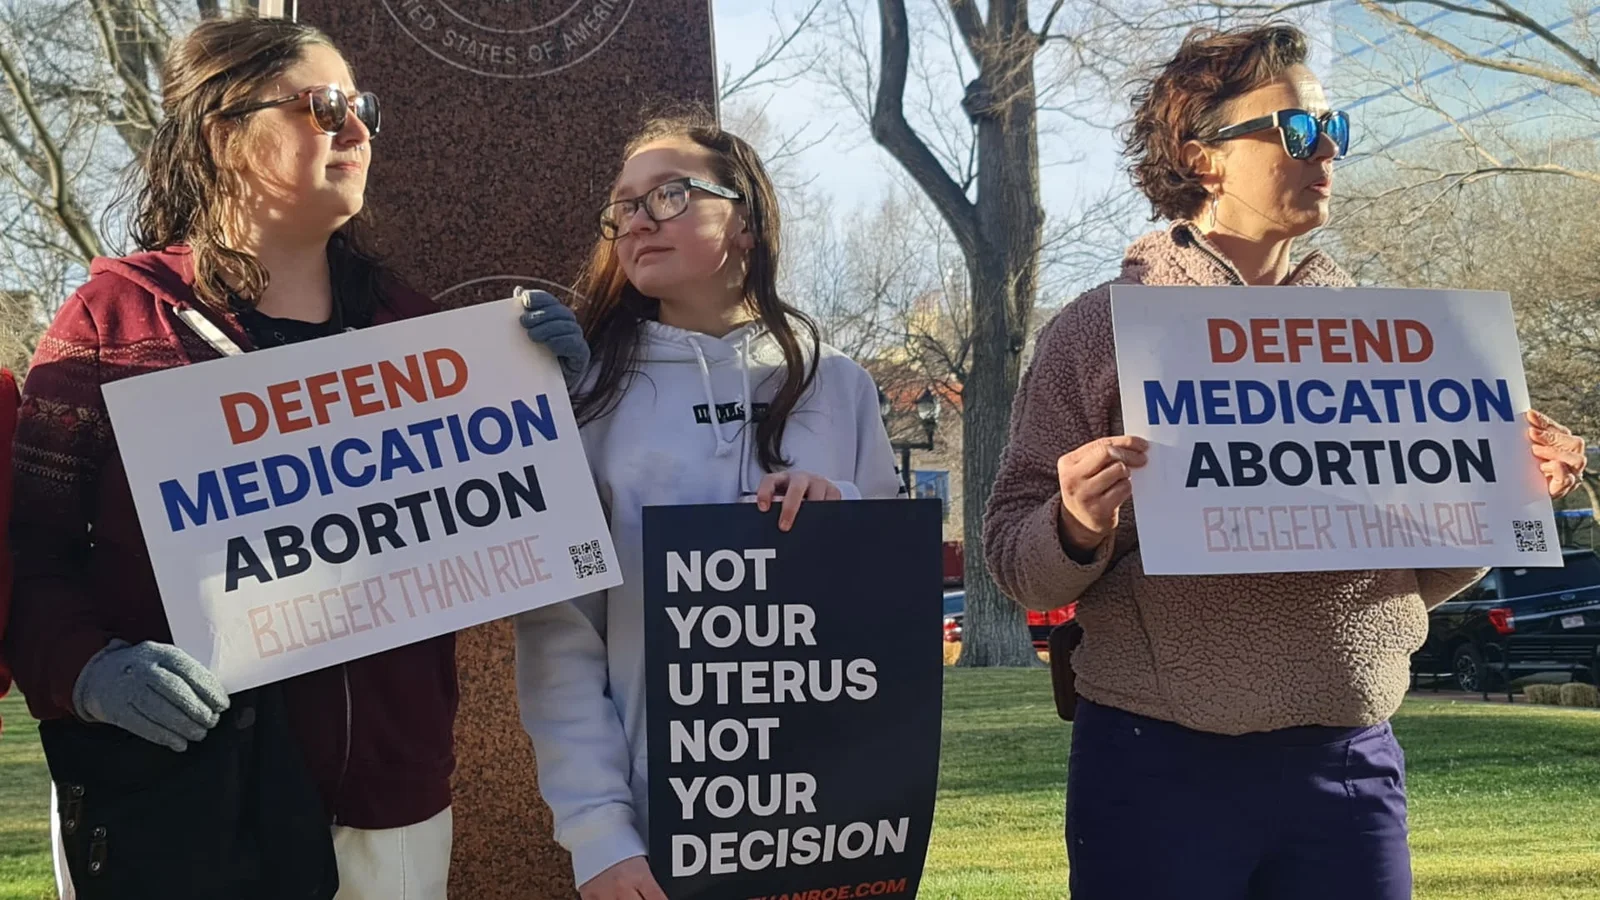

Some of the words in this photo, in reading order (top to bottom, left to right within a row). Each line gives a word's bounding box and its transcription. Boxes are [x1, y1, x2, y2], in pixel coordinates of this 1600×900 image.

[441, 30, 517, 64] STATES
[528, 40, 554, 62] OF
[561, 0, 619, 51] AMERI
[1207, 318, 1434, 363] DEFEND
[219, 348, 469, 445] DEFEND
[1143, 378, 1515, 425] MEDICATION
[158, 393, 559, 532] MEDICATION
[1185, 439, 1497, 488] ABORTION
[224, 465, 547, 592] ABORTION
[1202, 504, 1336, 552] BIGGER
[1336, 502, 1431, 549] THAN
[1433, 501, 1494, 547] ROE
[666, 549, 777, 592] NOT
[247, 575, 396, 659] BIGGER
[389, 550, 491, 618] THAN
[487, 535, 553, 594] ROE
[665, 604, 817, 649] YOUR
[668, 658, 878, 705] UTERUS
[669, 717, 780, 763] NOT
[668, 773, 817, 820] YOUR
[671, 817, 910, 877] DECISION
